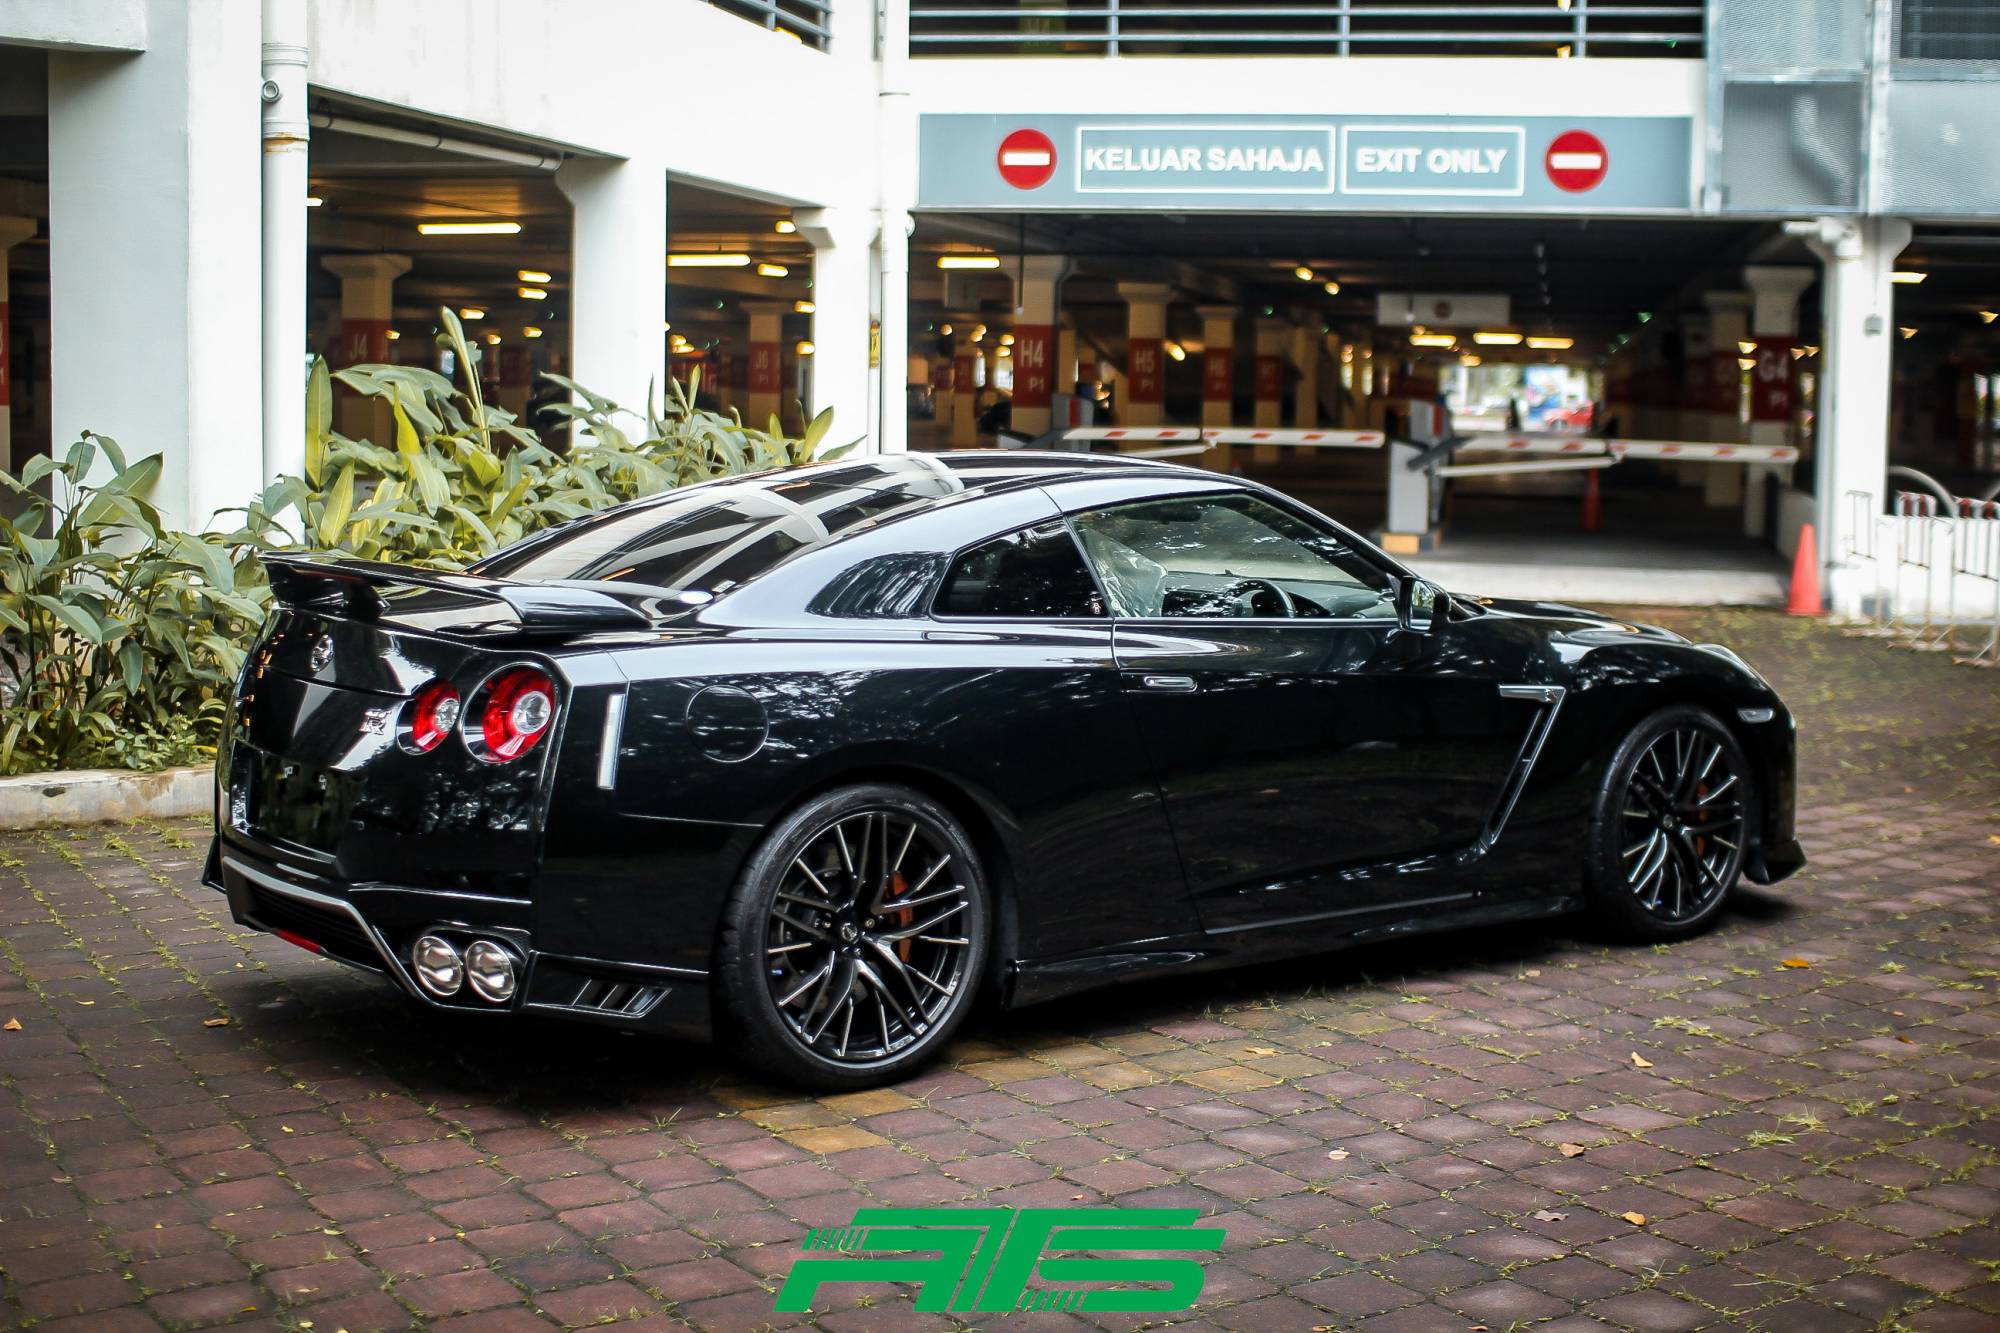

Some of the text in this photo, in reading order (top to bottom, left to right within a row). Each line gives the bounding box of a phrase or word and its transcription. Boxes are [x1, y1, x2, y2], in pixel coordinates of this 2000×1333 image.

[1086, 147, 1324, 172] KELUAR SAHAJA
[1356, 148, 1507, 173] EXIT ONLY
[1020, 340, 1044, 368] H4
[1029, 377, 1044, 392] P1
